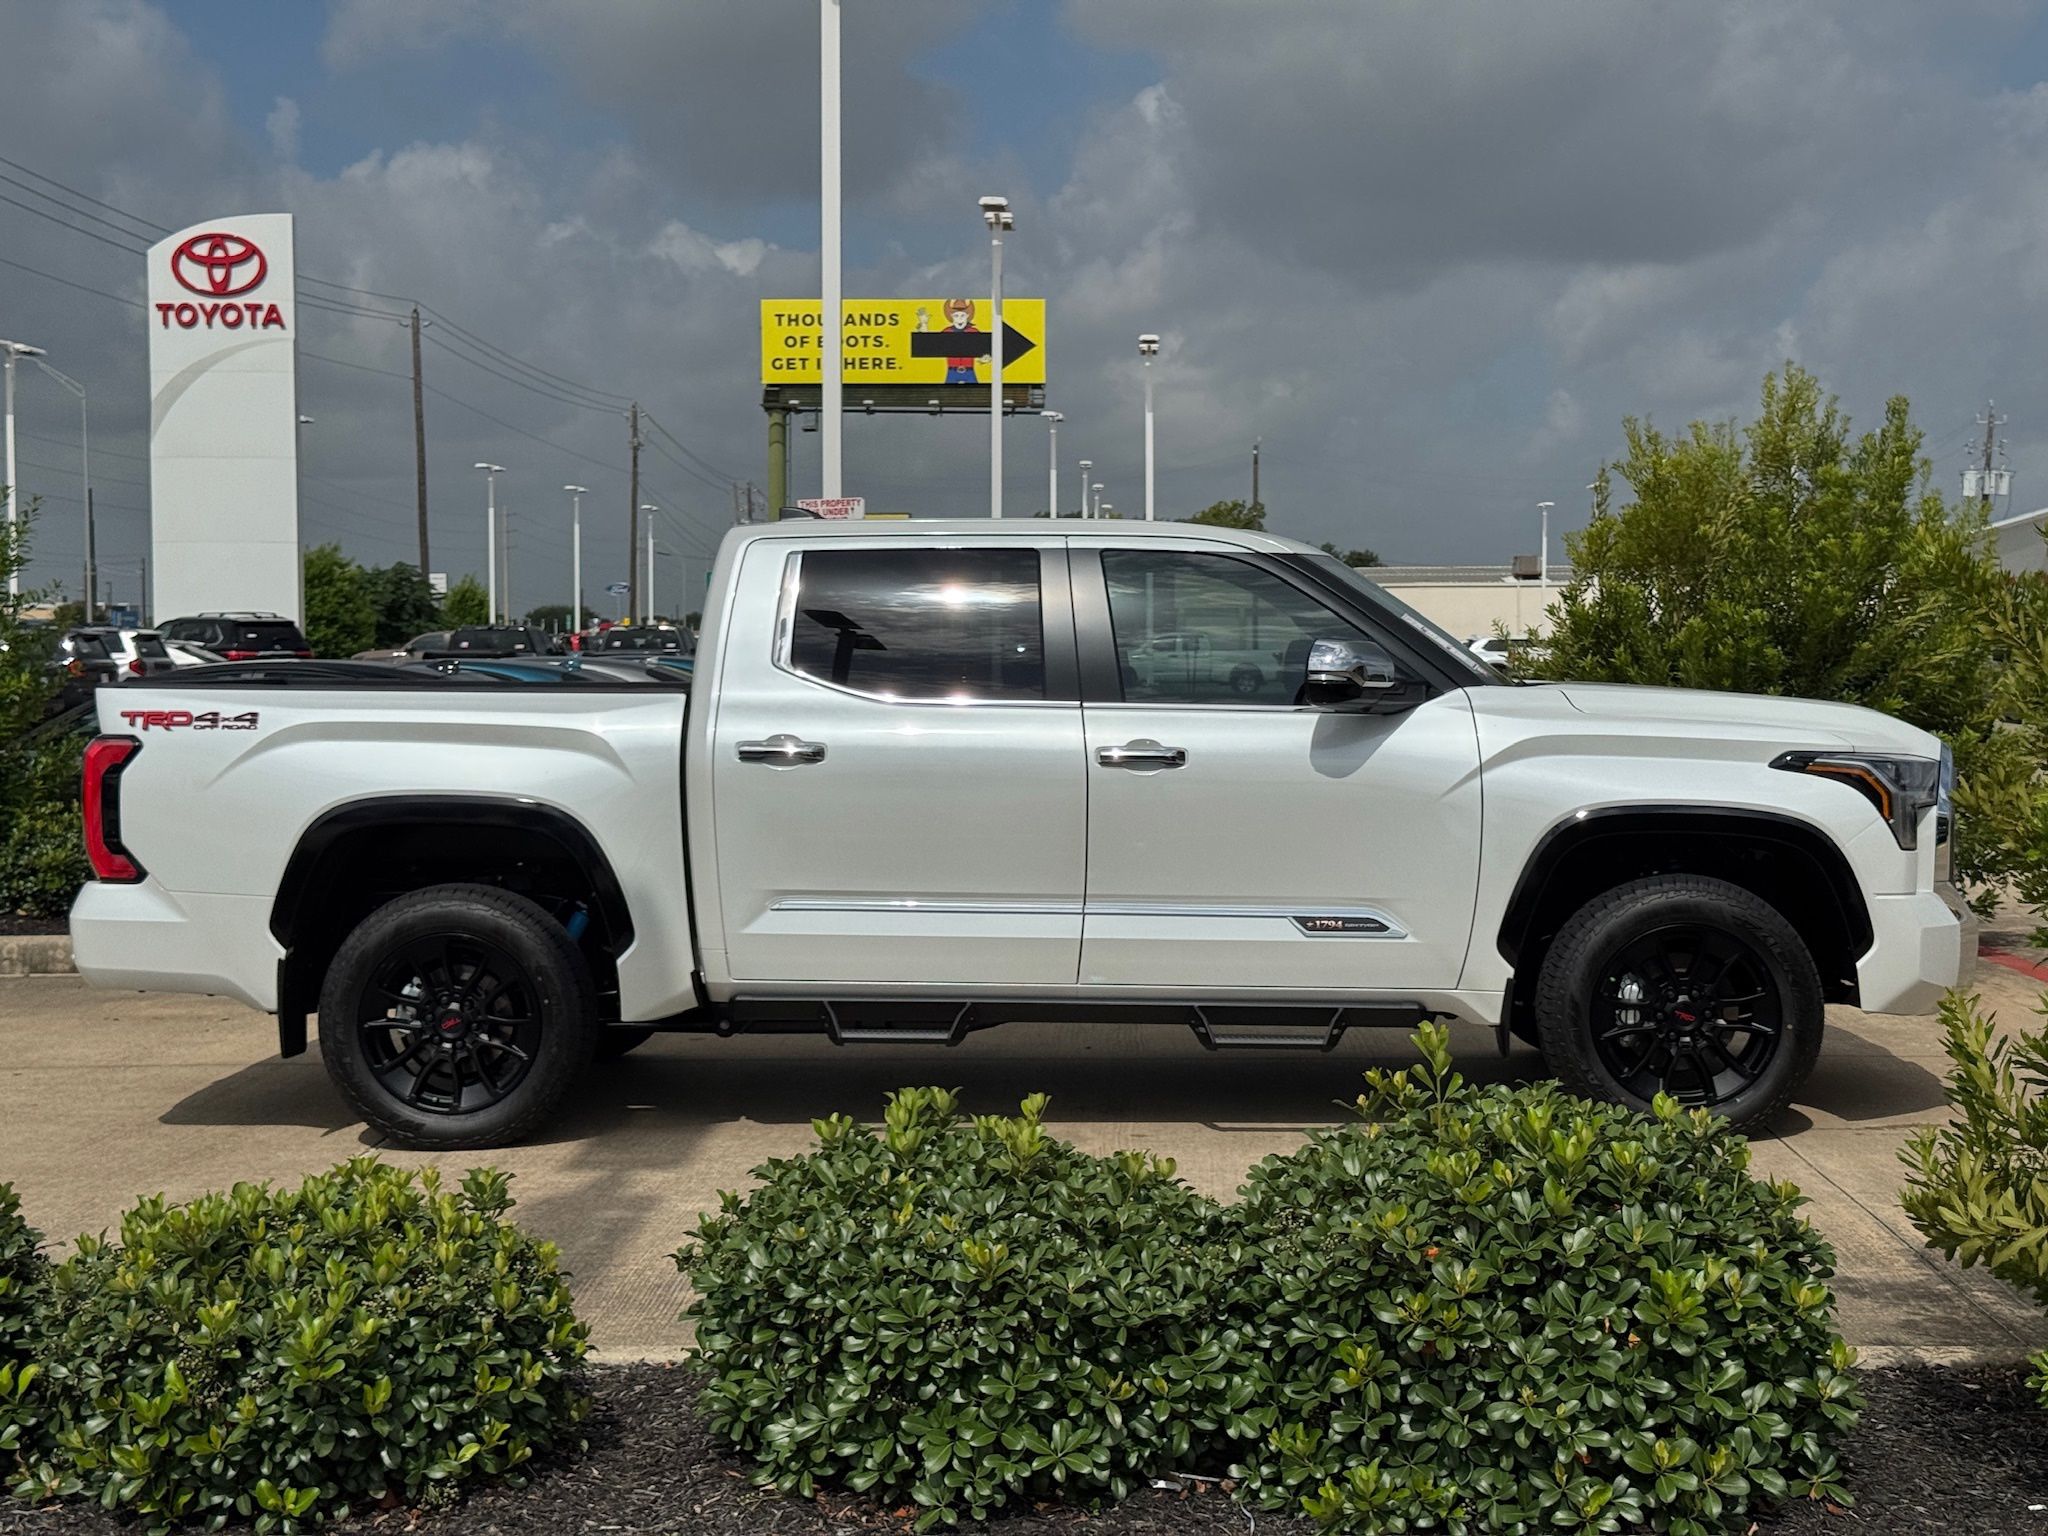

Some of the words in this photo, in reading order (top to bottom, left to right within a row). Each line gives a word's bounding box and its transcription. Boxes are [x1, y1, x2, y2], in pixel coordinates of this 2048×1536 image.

[155, 303, 286, 330] TOYOTA
[774, 313, 900, 327] THOANDS
[784, 335, 810, 348] OF
[817, 335, 890, 348] BOTS.
[771, 357, 810, 370] GET
[843, 357, 903, 370] HERE.
[800, 500, 819, 508] THIS
[820, 498, 862, 508] PROPERTY
[822, 507, 849, 516] UNDER
[120, 711, 194, 731] TRD
[1315, 920, 1344, 929] 1794
